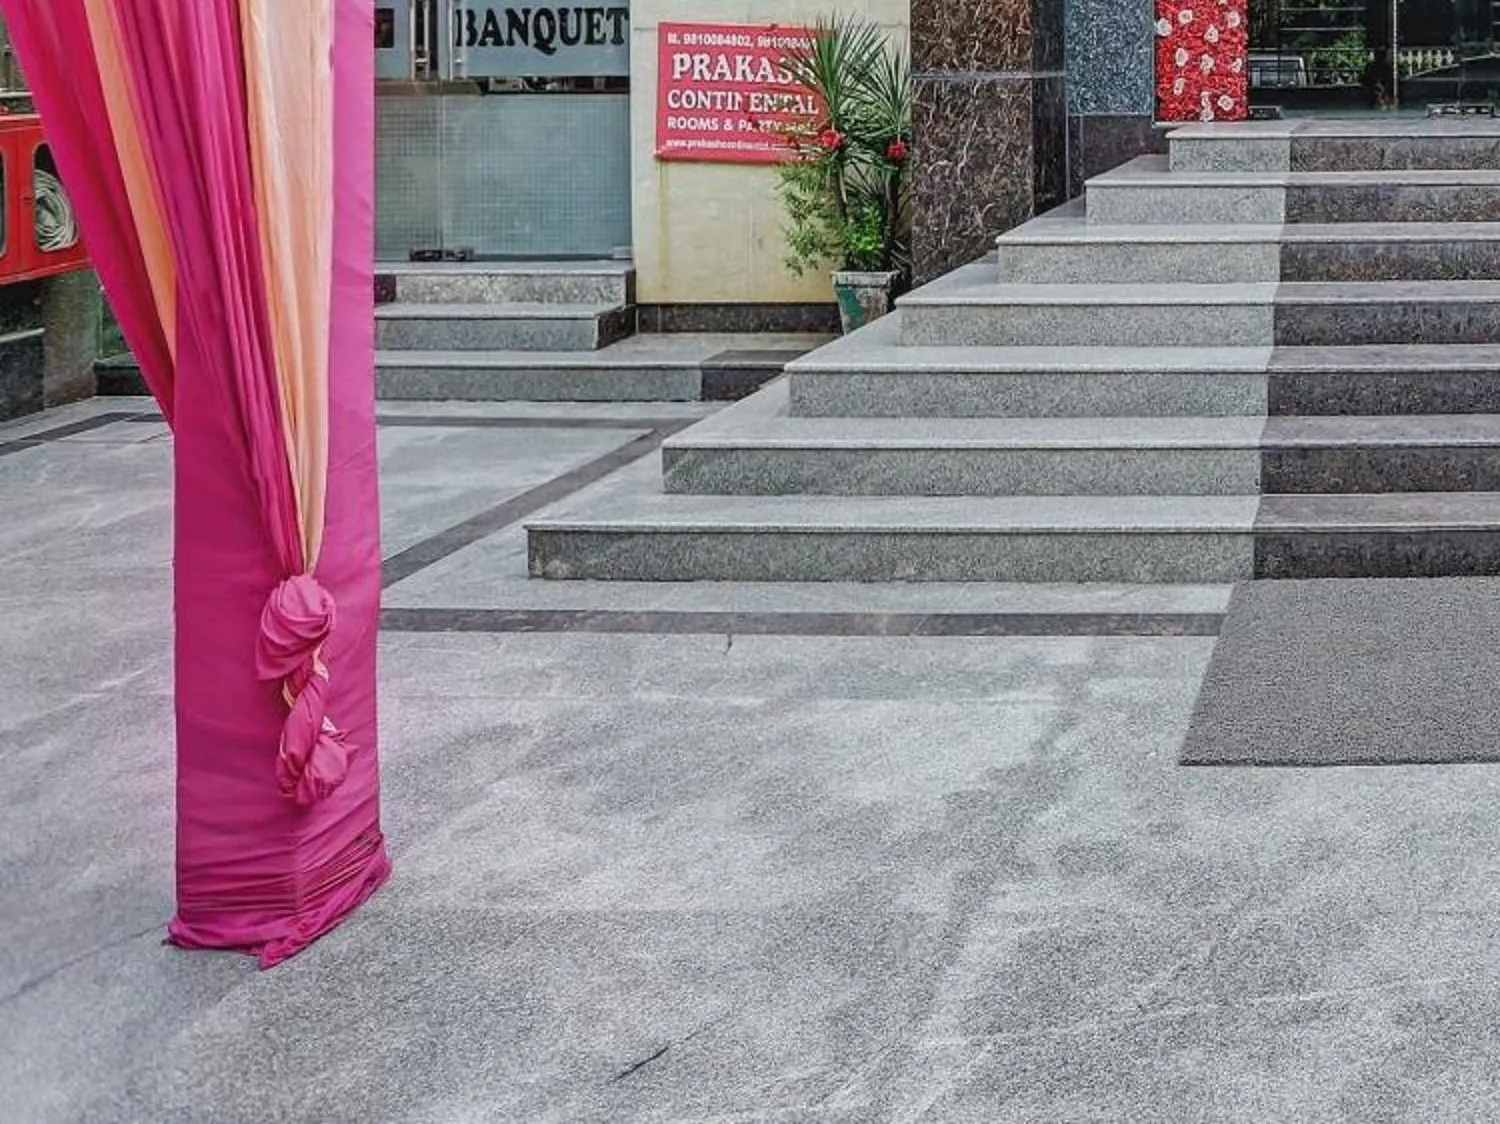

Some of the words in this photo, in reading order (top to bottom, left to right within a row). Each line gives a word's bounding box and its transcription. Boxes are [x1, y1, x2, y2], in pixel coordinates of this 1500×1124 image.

[455, 7, 630, 56] BANQUET
[667, 116, 720, 131] ROOMS
[723, 118, 733, 131] &
